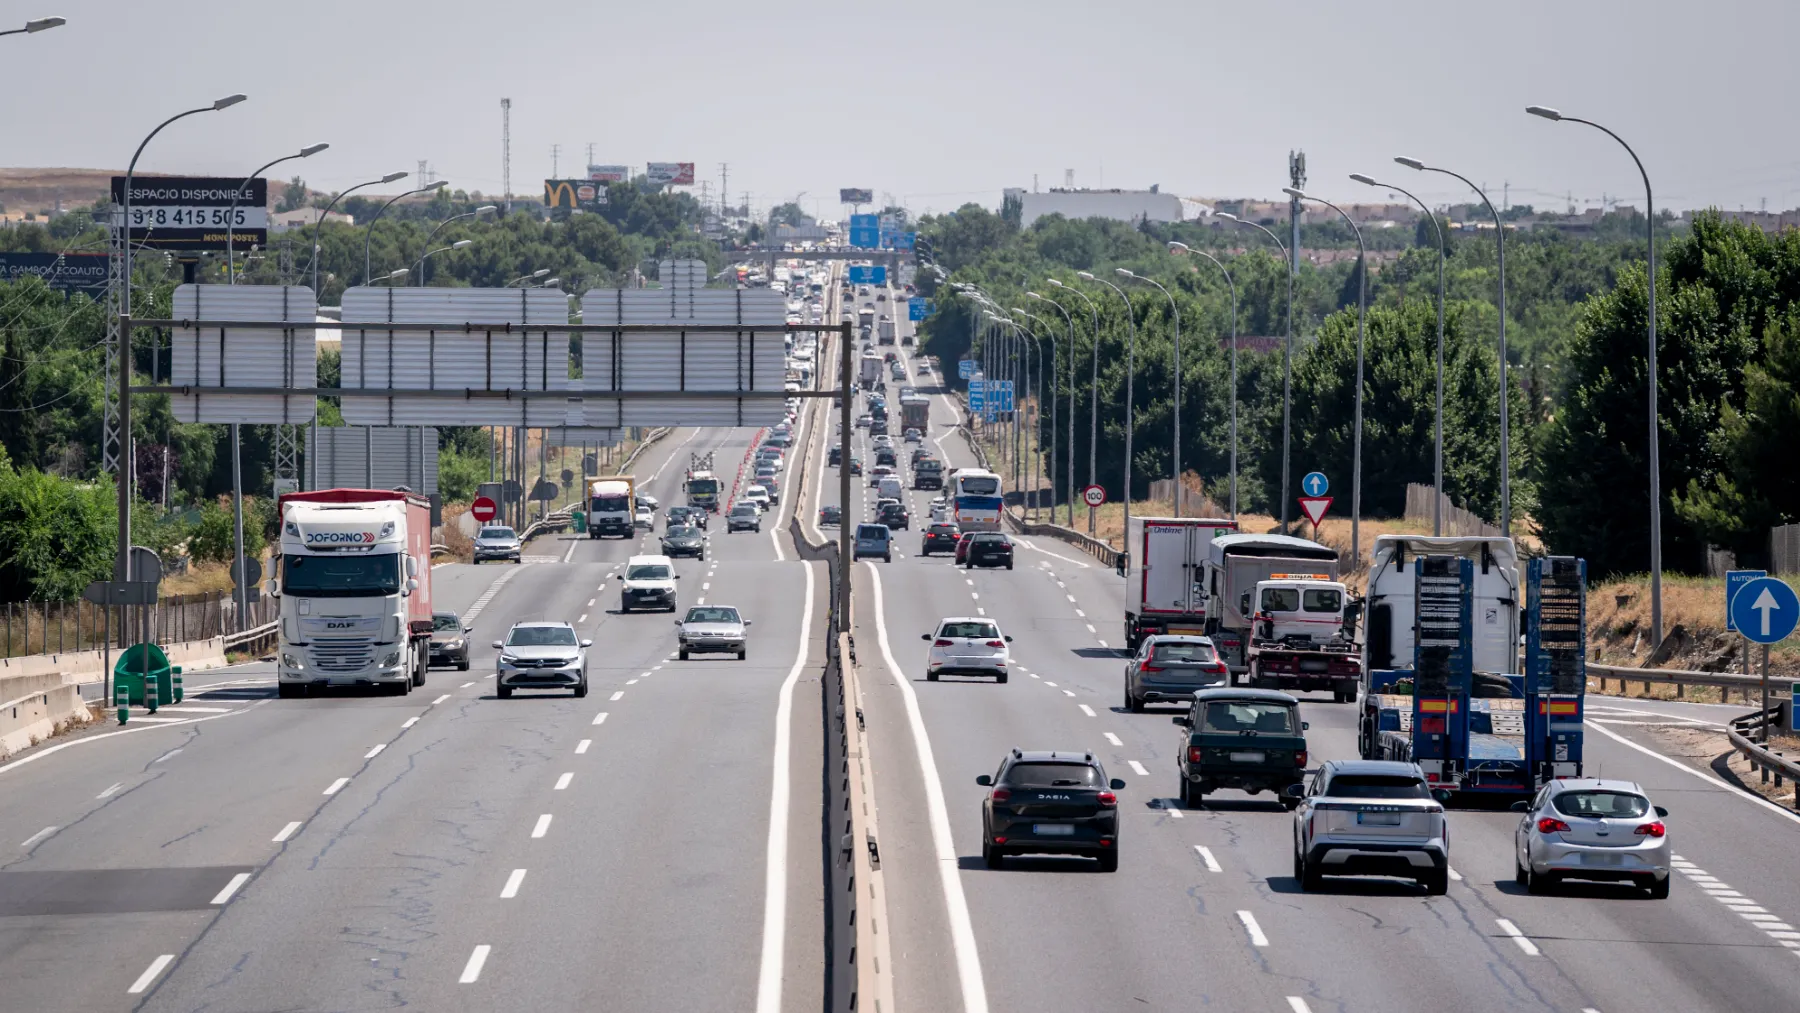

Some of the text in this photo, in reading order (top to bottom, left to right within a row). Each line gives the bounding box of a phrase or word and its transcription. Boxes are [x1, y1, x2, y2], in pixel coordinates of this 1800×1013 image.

[128, 188, 253, 200] ESPACIO DISPONIBLE
[133, 209, 245, 225] 918 415 505
[203, 234, 258, 242] MONOPOSTE
[10, 265, 54, 275] GAMBOA
[56, 266, 104, 276] ECOAUTO
[1087, 492, 1102, 500] 100
[307, 533, 363, 542] DOFORNO
